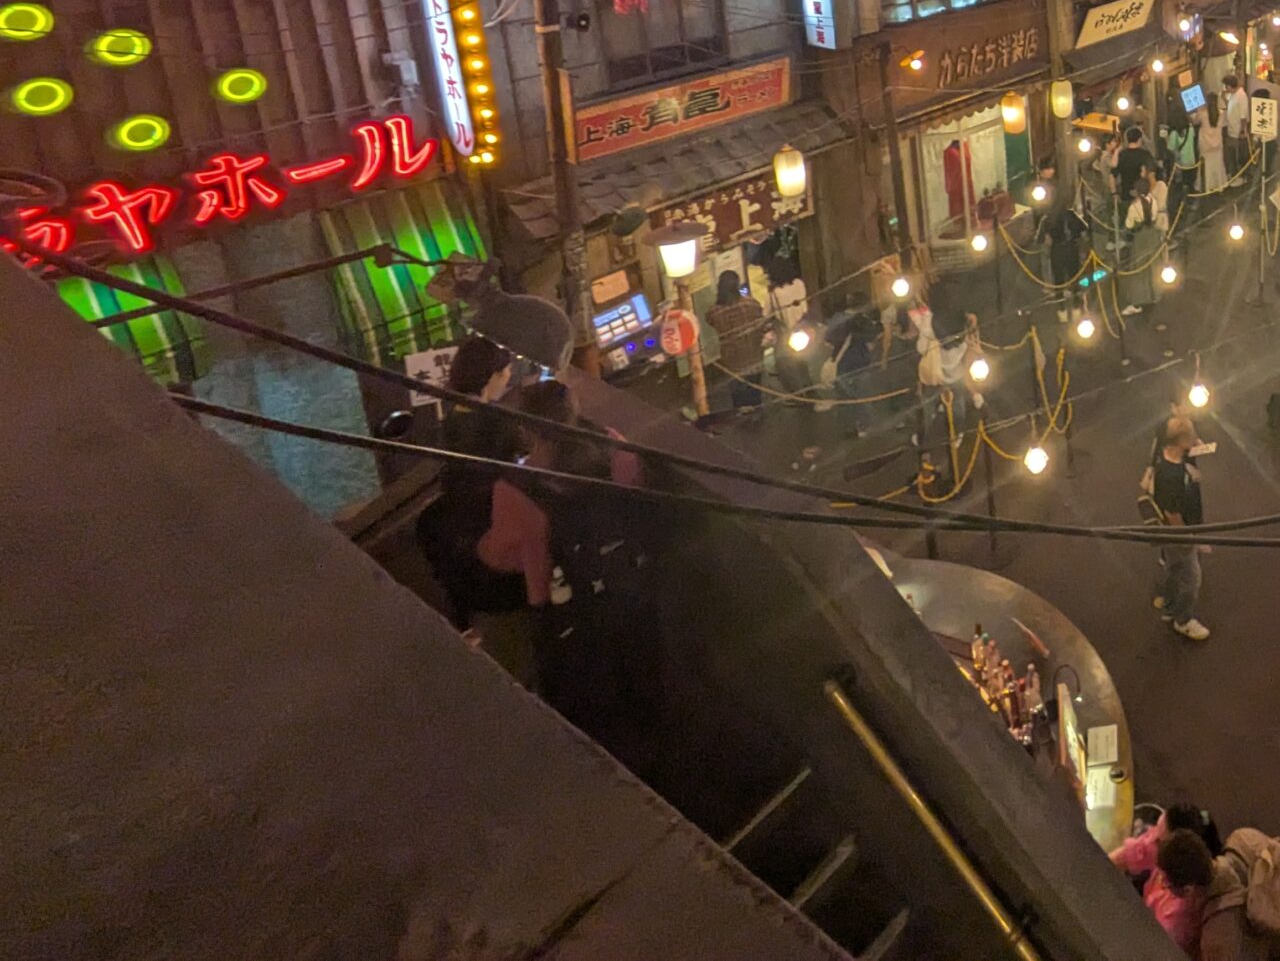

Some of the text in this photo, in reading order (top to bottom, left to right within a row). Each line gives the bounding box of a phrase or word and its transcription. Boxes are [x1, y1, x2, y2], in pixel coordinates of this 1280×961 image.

[8, 117, 435, 257] ラヤホール
